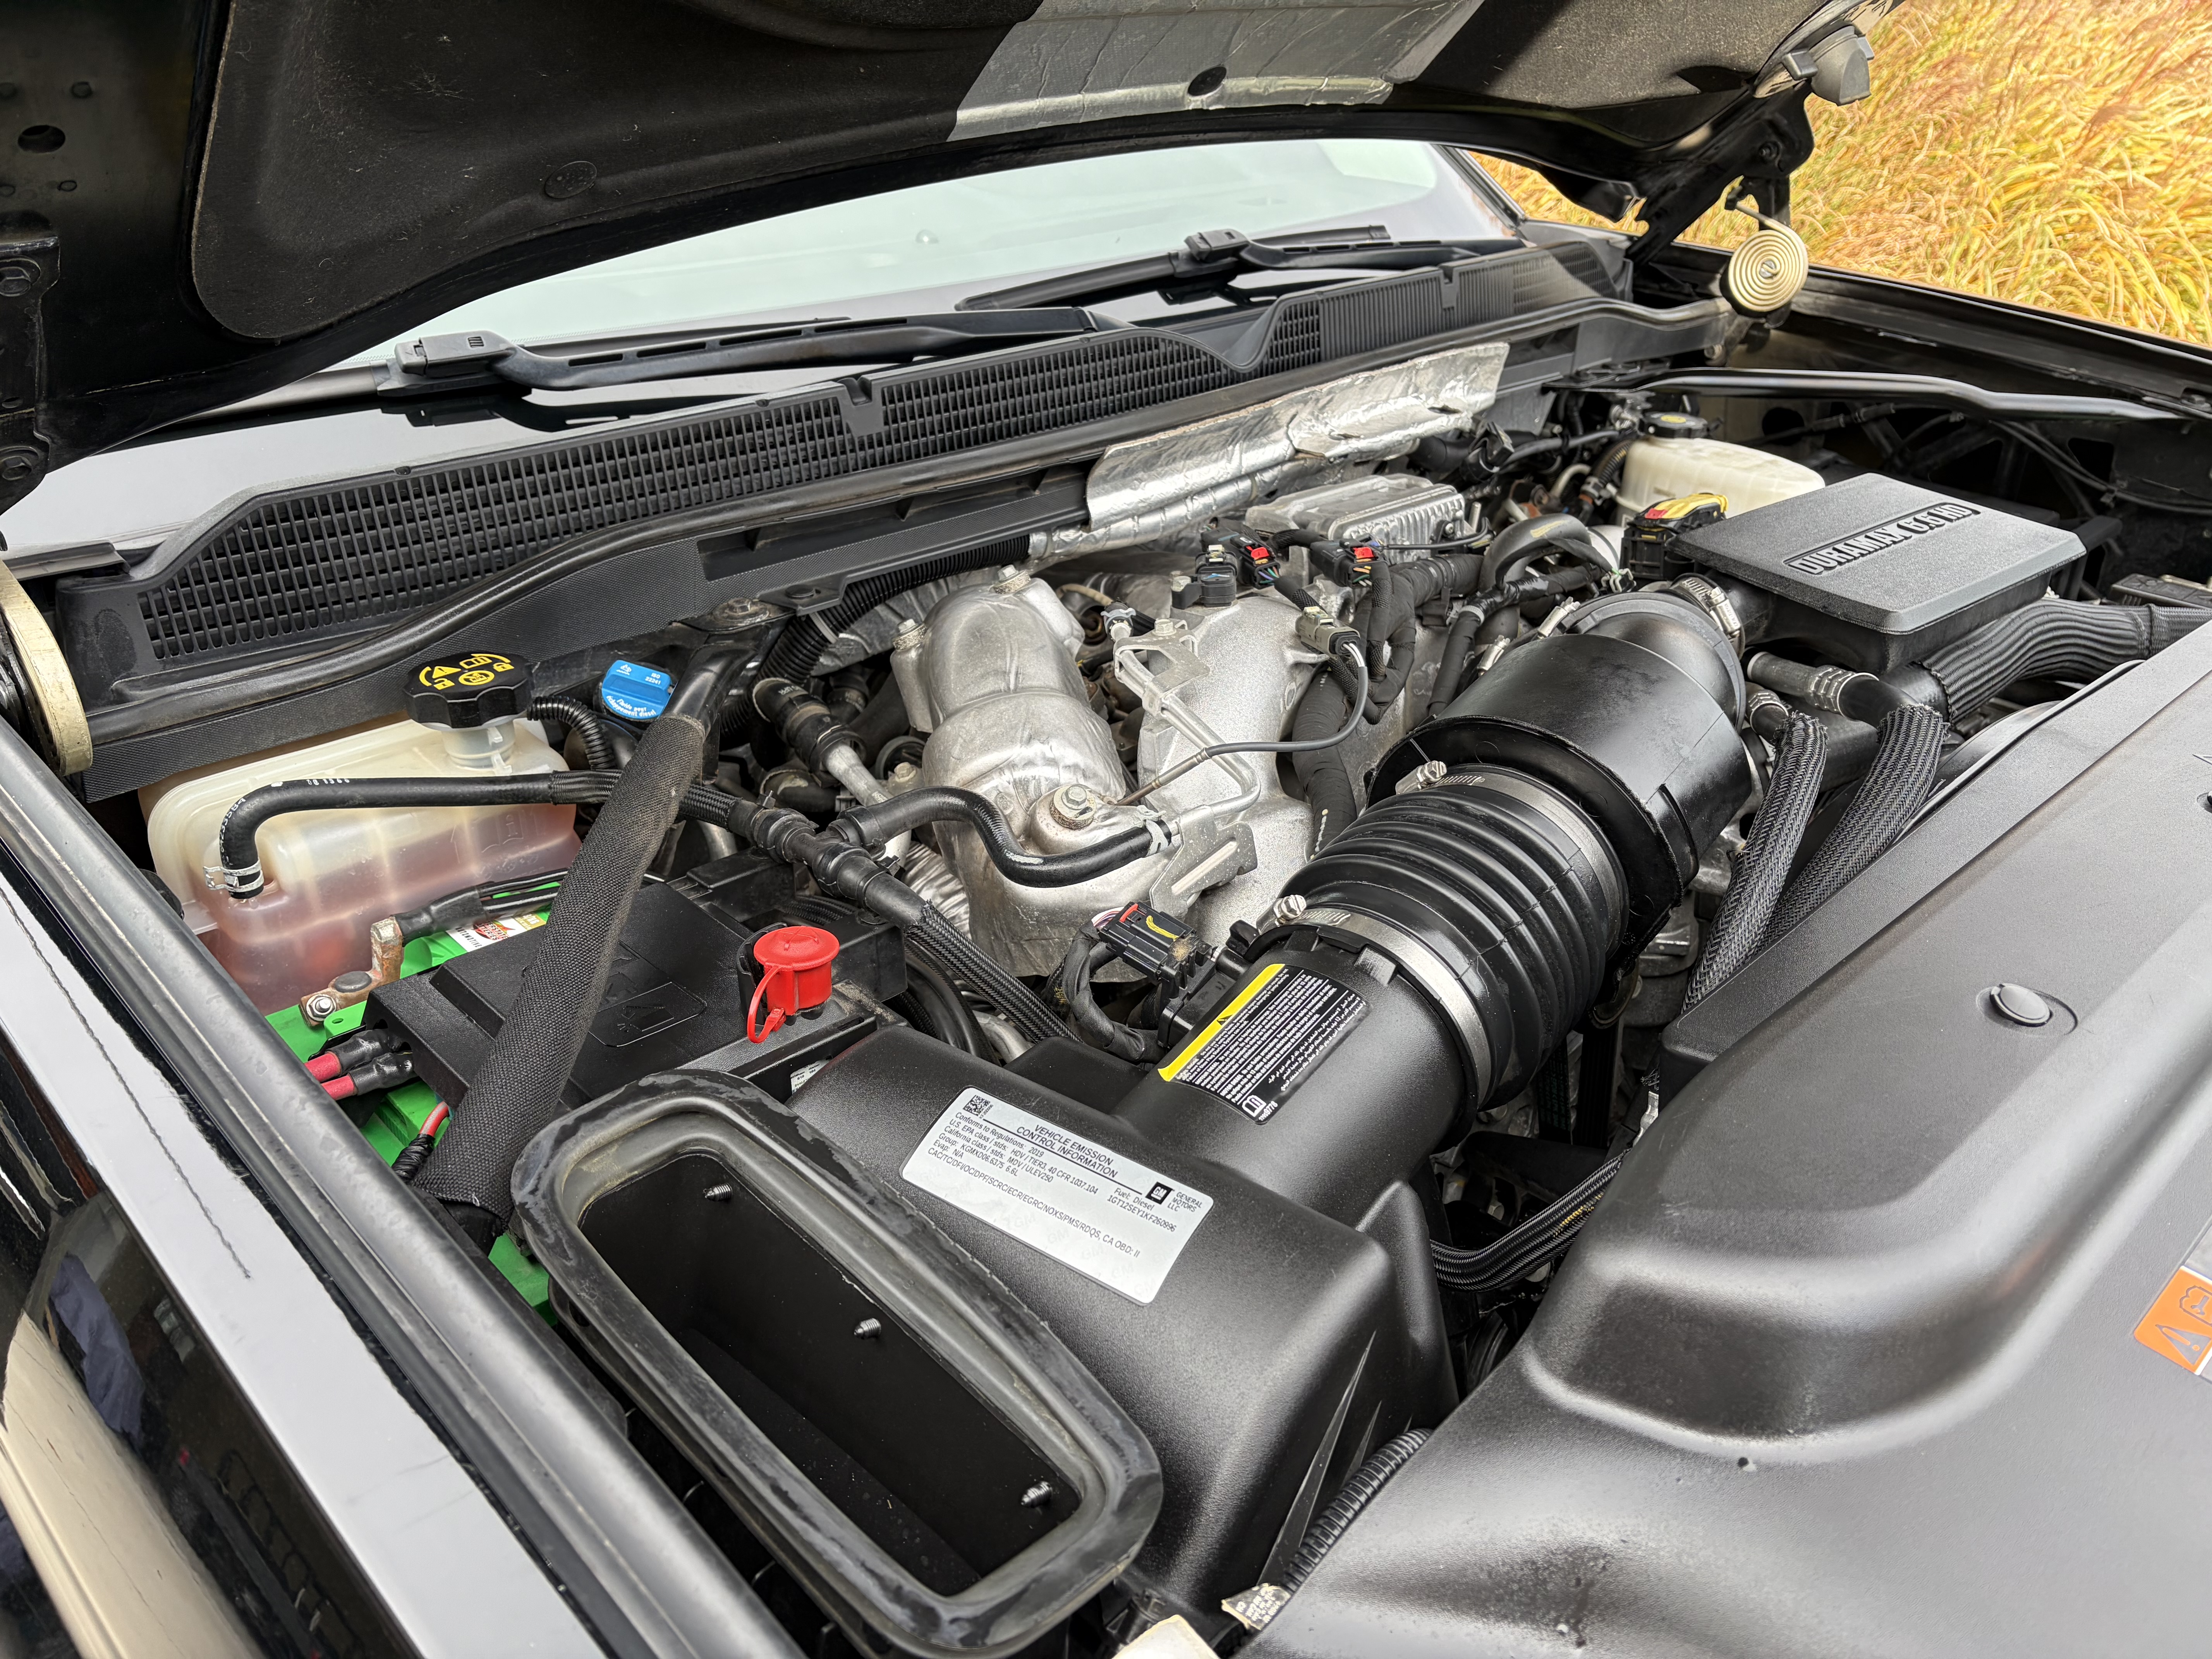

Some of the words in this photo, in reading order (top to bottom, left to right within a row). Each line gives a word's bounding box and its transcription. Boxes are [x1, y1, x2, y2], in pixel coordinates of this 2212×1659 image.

[1788, 527, 1912, 575] DURAMAX
[1897, 515, 1946, 534] 6.6
[1927, 504, 1973, 522] HD
[645, 677, 661, 685] 22241
[955, 1112, 983, 1129] Conforms
[989, 1128, 1026, 1149] Regulations:
[1028, 1147, 1044, 1157] 2019
[1035, 1124, 1071, 1146] VEHICLE
[1070, 1141, 1113, 1165] EMISSION
[933, 1139, 951, 1151] Evap:
[952, 1149, 963, 1159] N/A
[936, 1133, 958, 1146] Group:
[960, 1143, 1005, 1168] KGMXD06.6375
[1005, 1165, 1018, 1176] 6.6L
[944, 1126, 971, 1143] California
[971, 1140, 987, 1150] class
[990, 1149, 1005, 1159] stds:
[1007, 1156, 1023, 1167] MDV
[1025, 1165, 1053, 1182] ULEV250
[949, 1118, 961, 1128] U.S.
[961, 1125, 974, 1135] EPA
[974, 1132, 989, 1142] class
[993, 1141, 1008, 1151] stds:
[1010, 1148, 1025, 1158] HDV
[1028, 1156, 1047, 1171] TIER3,
[1056, 1170, 1071, 1181] CFR
[1070, 1177, 1098, 1194] 1037.104
[1017, 1126, 1055, 1150] CONTROL
[1057, 1145, 1118, 1178] INFORMATION
[1114, 1187, 1130, 1199] Fuel:
[1133, 1196, 1154, 1211] Diesel
[1151, 1185, 1168, 1199] GM
[1176, 1192, 1202, 1208] GENERAL
[1167, 1202, 1180, 1211] LLC
[1171, 1197, 1196, 1212] MOTORS
[1103, 1235, 1113, 1245] CA
[1115, 1240, 1133, 1254] OBD:
